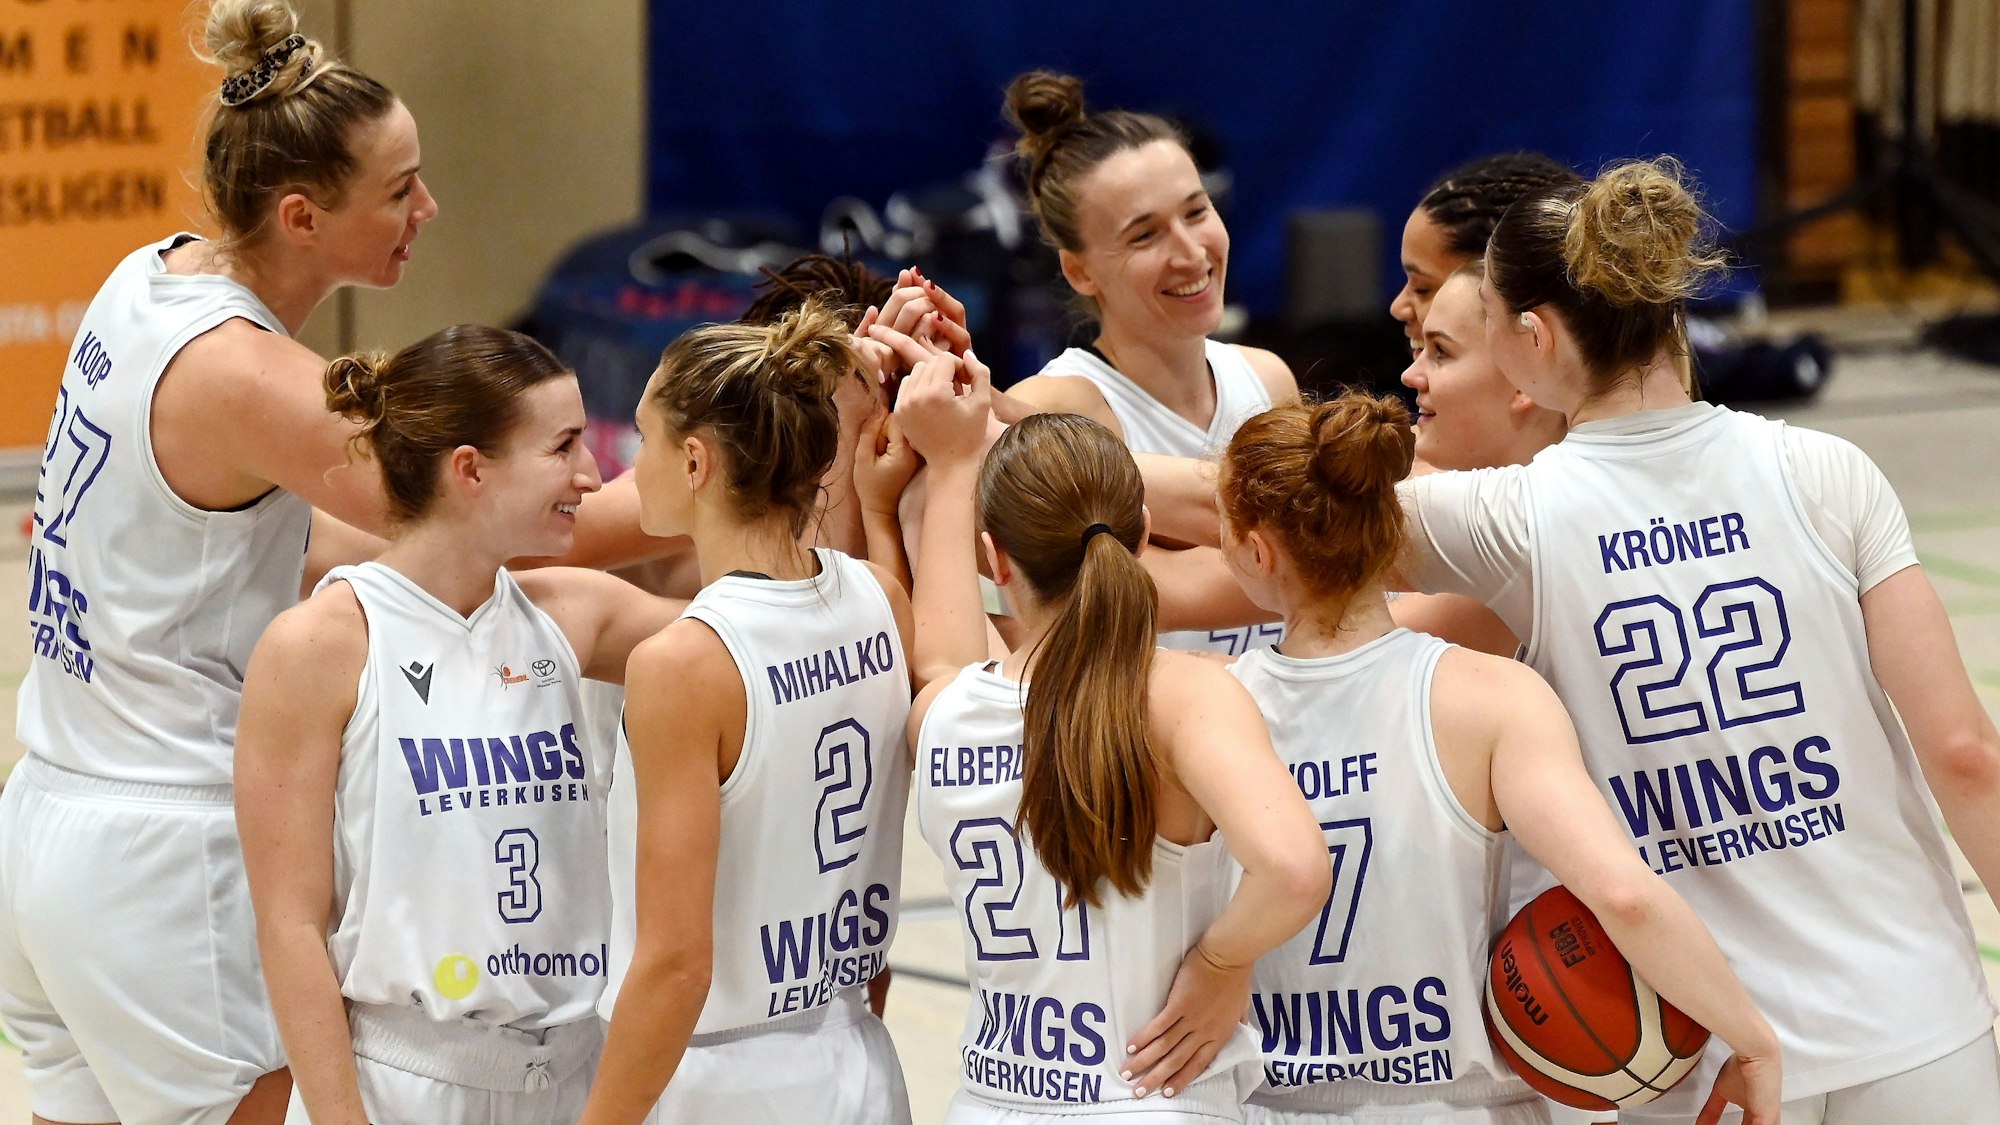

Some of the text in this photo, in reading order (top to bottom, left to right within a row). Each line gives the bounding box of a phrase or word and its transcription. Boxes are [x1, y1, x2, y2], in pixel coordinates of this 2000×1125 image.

[74, 331, 112, 391] KOOP
[1598, 512, 1751, 574] KRÖNER
[767, 631, 894, 705] MIHALKO
[1593, 576, 1806, 745] 22
[398, 723, 585, 795] WINGS
[814, 717, 872, 874] 2
[1289, 752, 1378, 800] OLFF
[1608, 735, 1840, 839] WINGS
[419, 784, 589, 816] LEVERKUSEN
[494, 828, 542, 924] 3
[1309, 817, 1373, 965] 7
[487, 943, 607, 977] orthomol
[1550, 919, 1586, 968] FIBA
[1252, 976, 1451, 1056] WINGS
[1501, 939, 1549, 1026] molten
